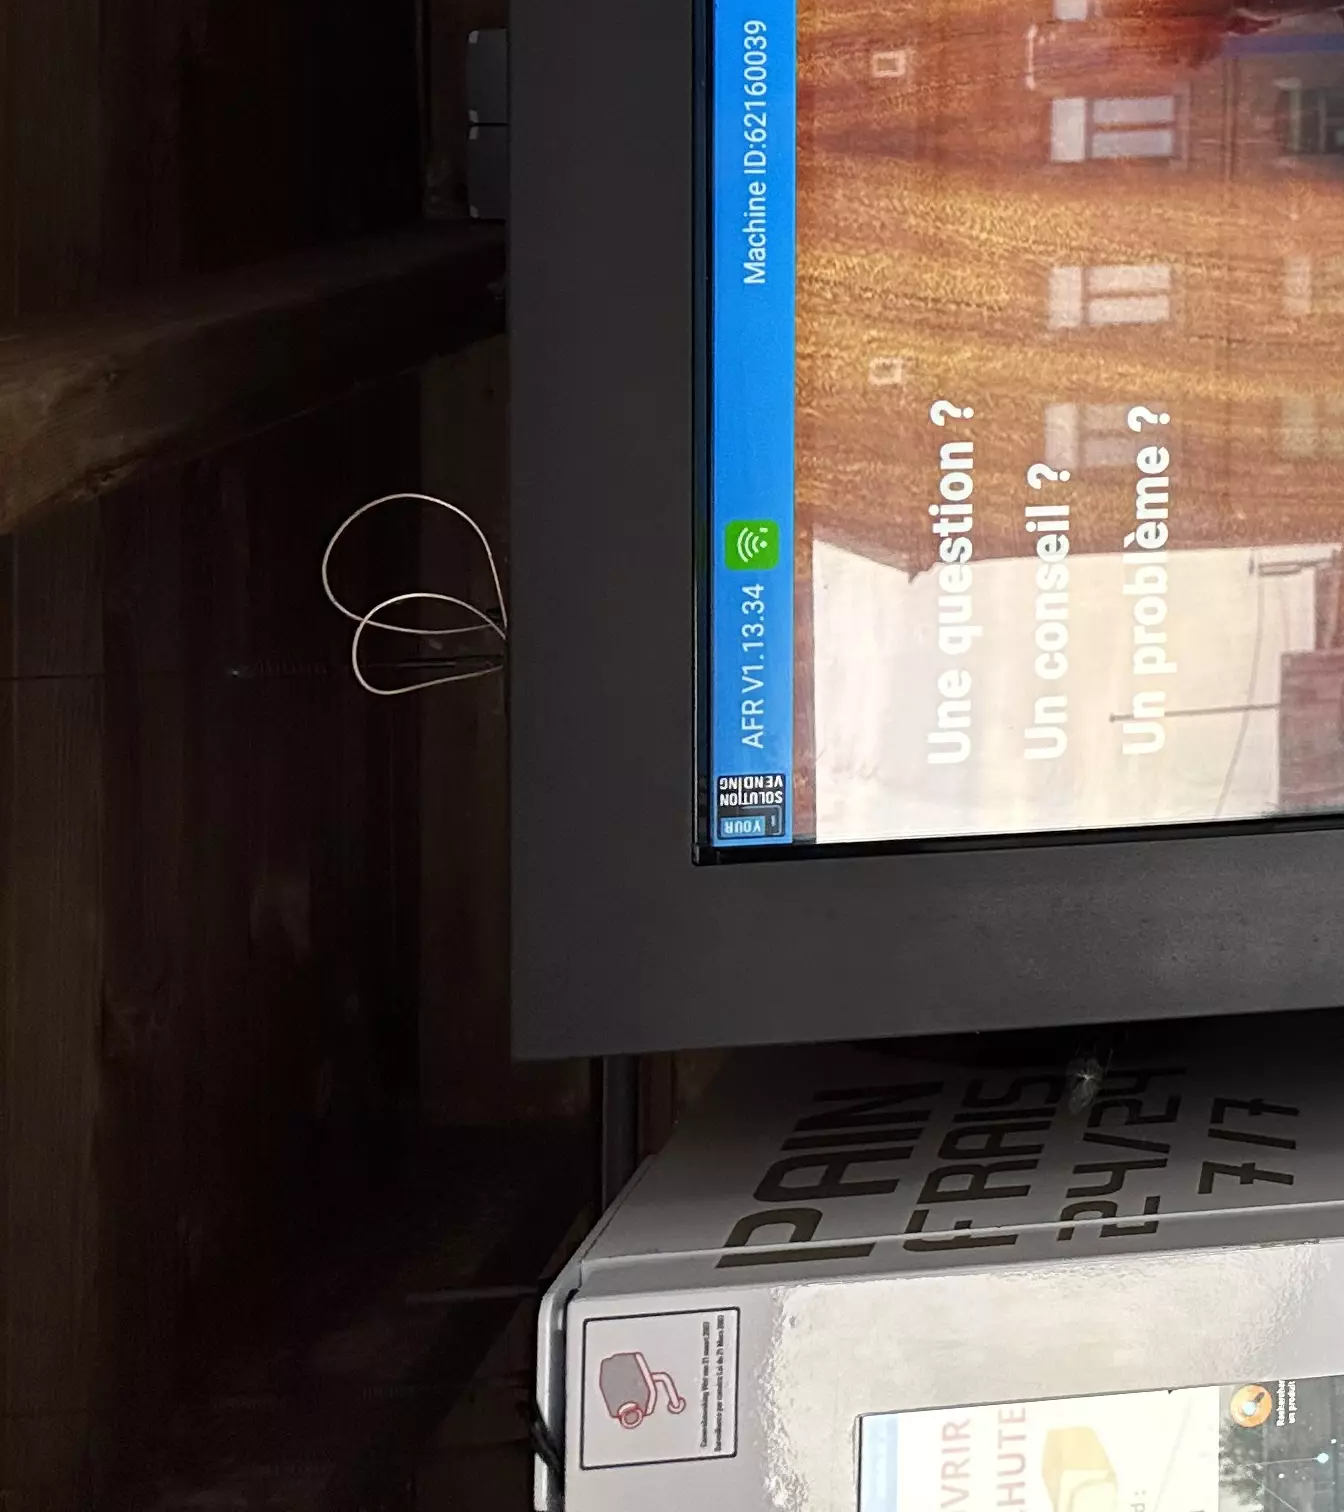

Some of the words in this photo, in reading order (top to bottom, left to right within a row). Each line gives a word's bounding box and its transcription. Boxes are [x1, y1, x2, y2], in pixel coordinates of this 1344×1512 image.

[742, 19, 770, 176] ID:62160039
[742, 180, 769, 285] Machine
[930, 399, 974, 426] ?
[1127, 405, 1170, 433] ?
[1027, 462, 1071, 490] ?
[929, 441, 983, 655] question
[1025, 505, 1070, 679] conseil
[1122, 446, 1177, 674] problème
[741, 583, 766, 689] V1.13.34
[741, 699, 765, 749] AFR
[927, 670, 971, 764] Une
[1024, 696, 1068, 760] Un
[1122, 692, 1166, 755] Un
[719, 775, 783, 789] VENDING
[719, 791, 783, 806] SOLUTION
[724, 820, 761, 833] YOUR
[715, 1081, 943, 1269] PAIN
[903, 1074, 1064, 1252] FRAIS
[1056, 1067, 1188, 1241] 24/24
[1198, 1098, 1300, 1194] 7/7
[940, 1419, 970, 1512] VRIR
[996, 1407, 1027, 1512] HUTE
